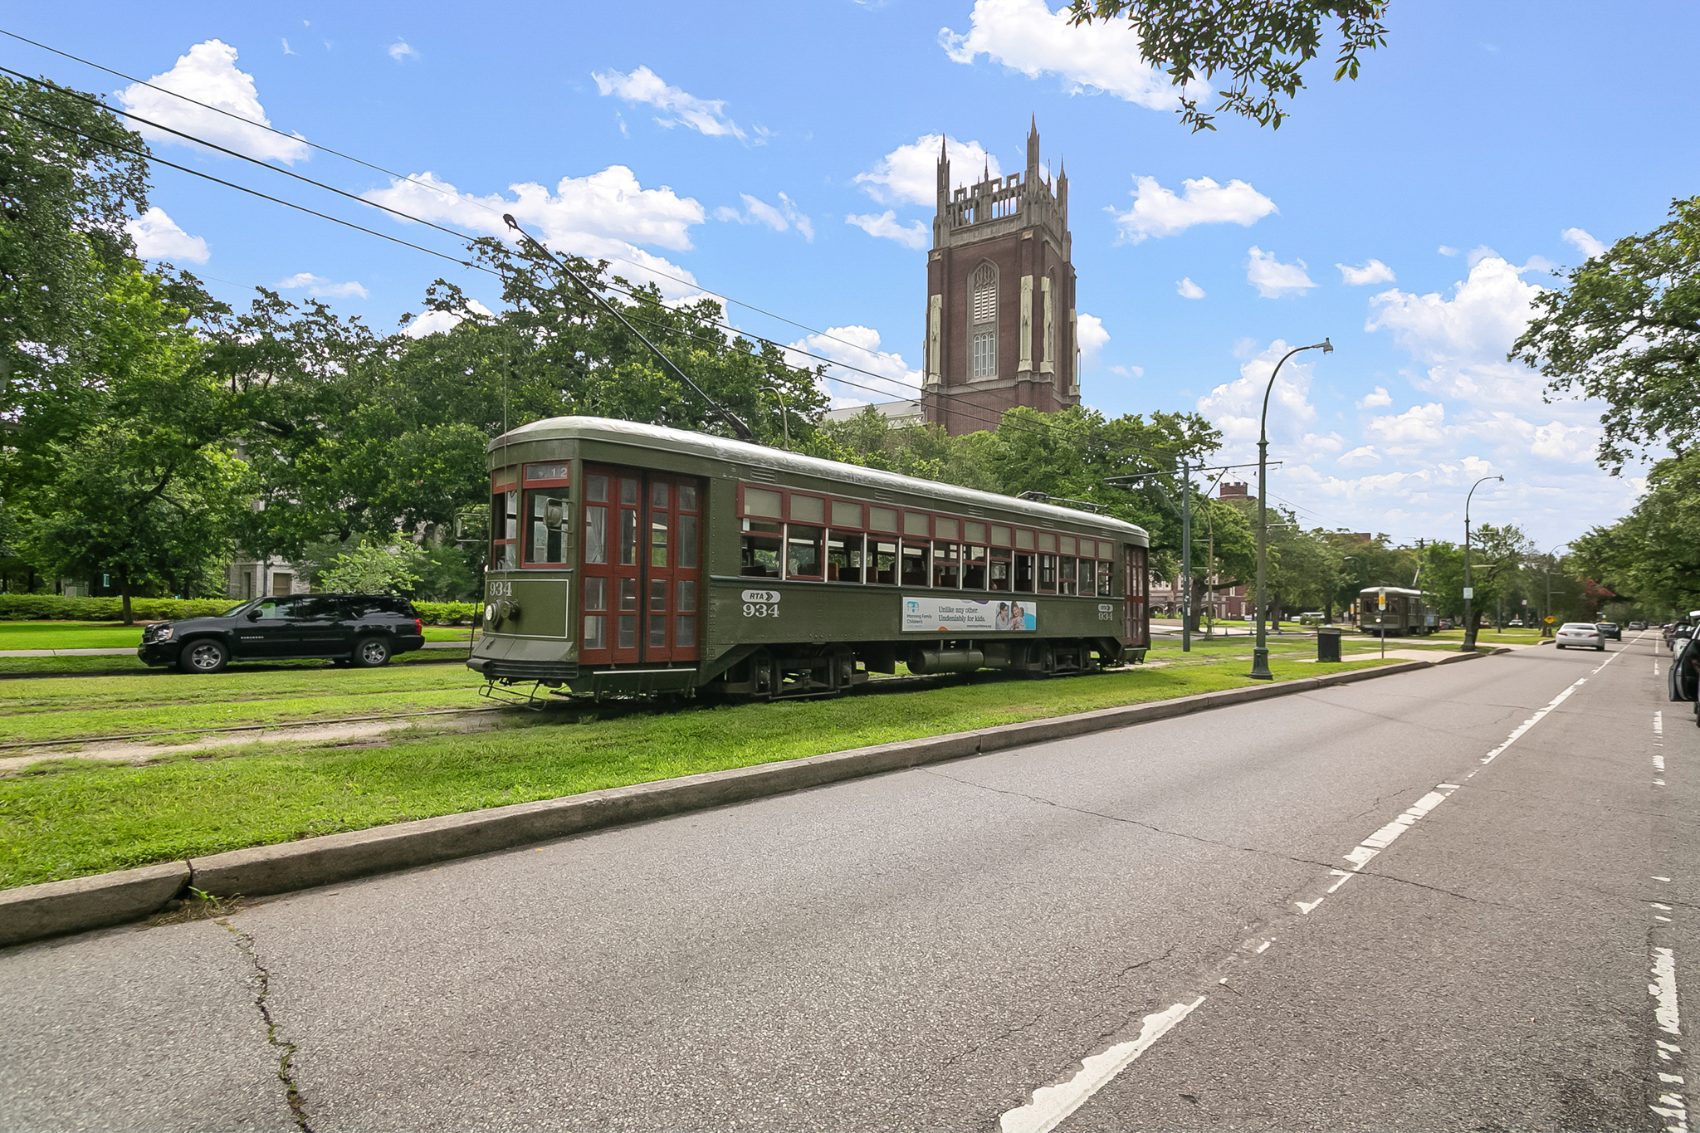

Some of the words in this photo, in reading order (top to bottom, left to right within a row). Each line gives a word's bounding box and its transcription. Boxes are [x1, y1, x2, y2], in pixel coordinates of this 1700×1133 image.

[490, 581, 512, 597] 934
[750, 592, 764, 600] RTA
[743, 603, 780, 618] 934
[1098, 612, 1113, 621] 934
